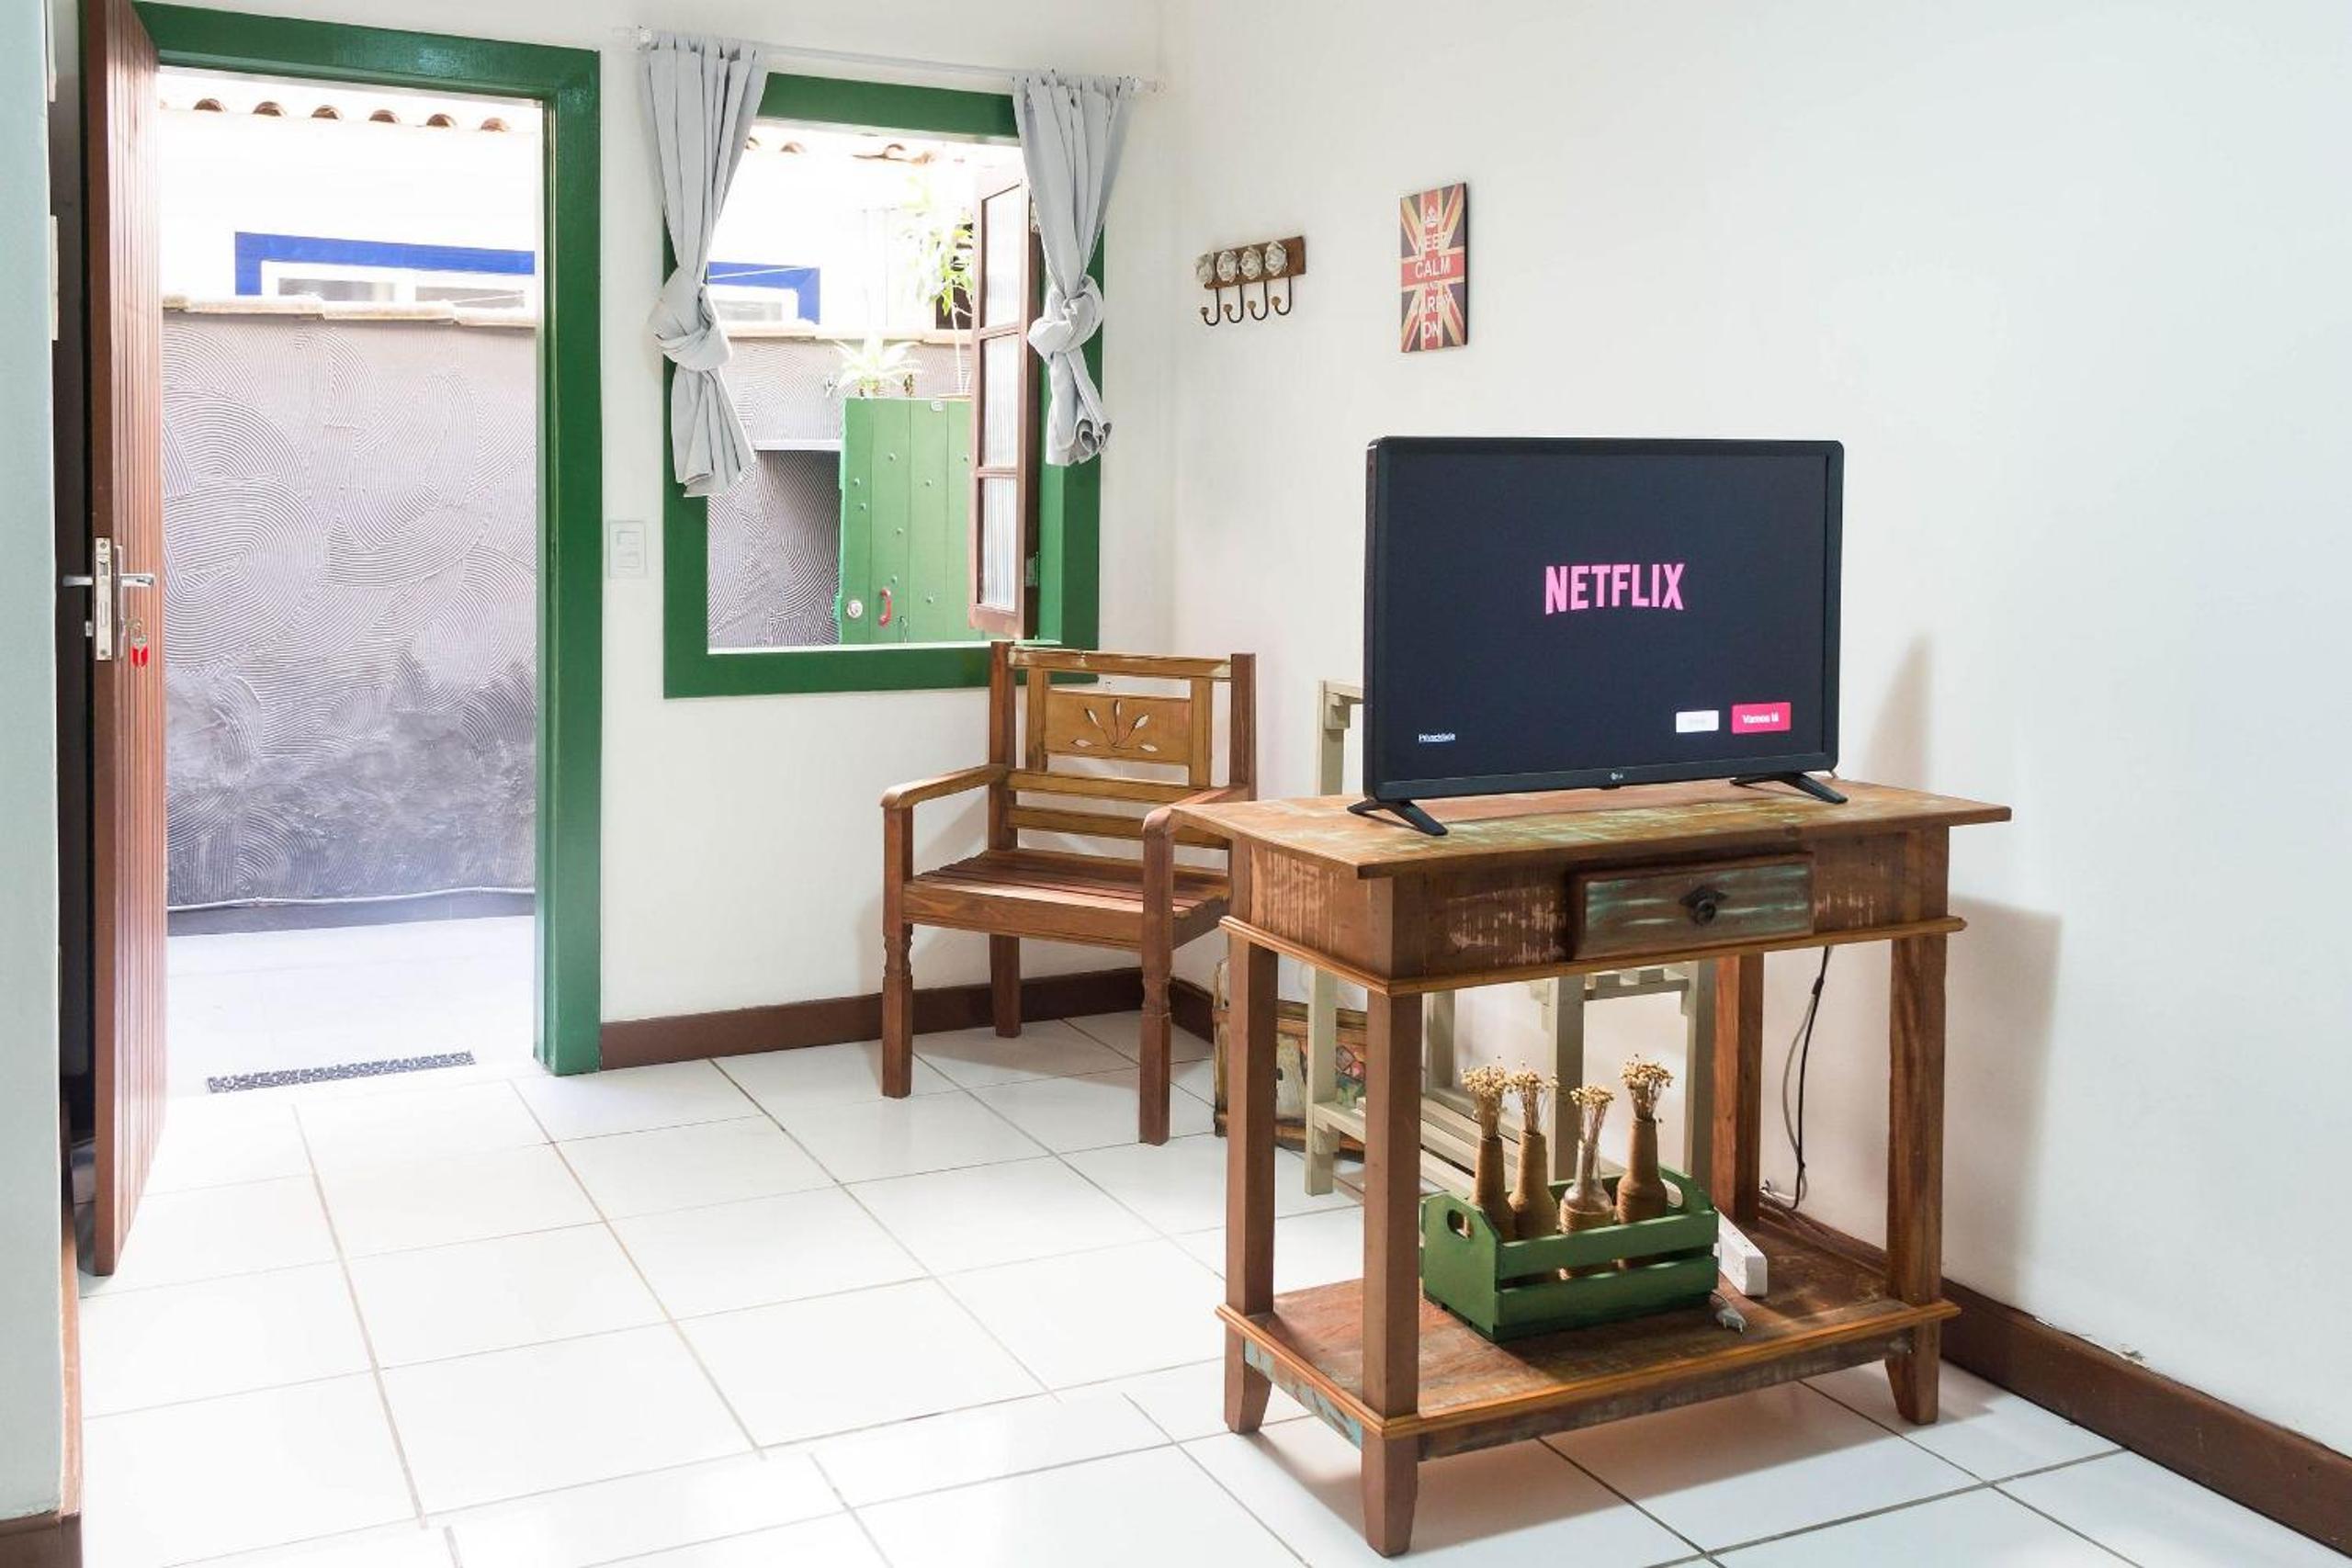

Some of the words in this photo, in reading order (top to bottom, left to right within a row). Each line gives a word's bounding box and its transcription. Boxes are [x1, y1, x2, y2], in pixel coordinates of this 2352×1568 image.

[1415, 256, 1451, 278] CALM
[1415, 293, 1452, 318] ARRY
[1423, 321, 1441, 339] ON
[1545, 563, 1685, 615] NETFLIX
[1742, 714, 1770, 724] Vamos
